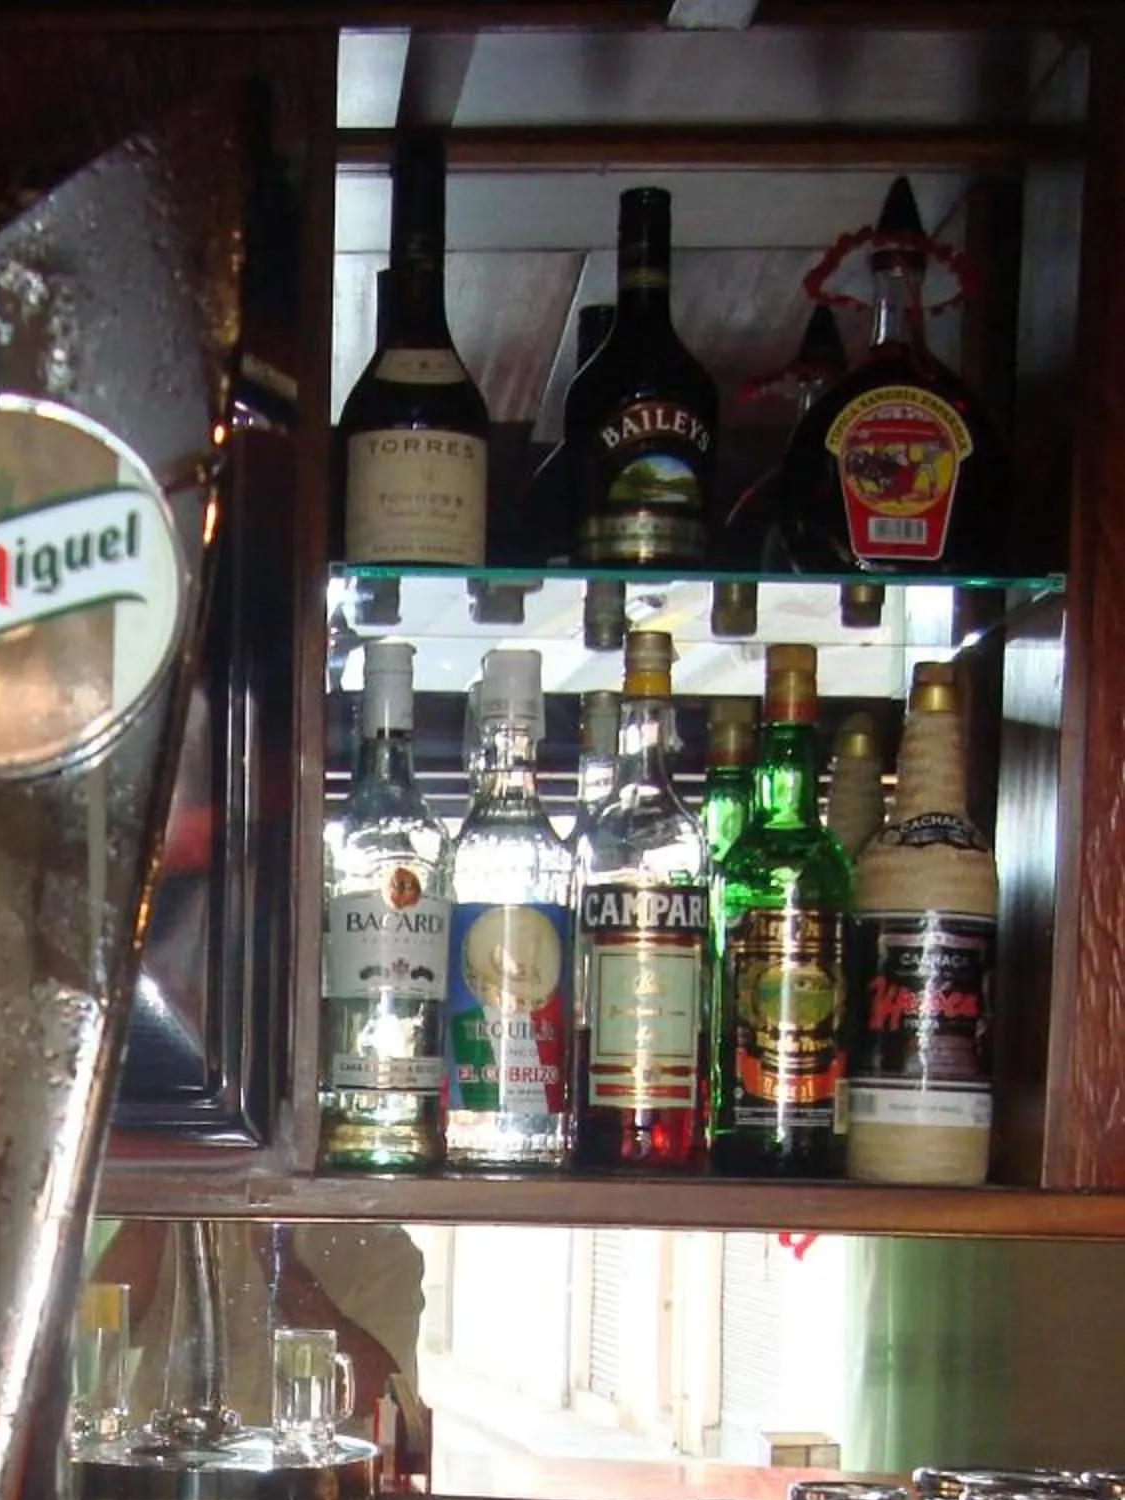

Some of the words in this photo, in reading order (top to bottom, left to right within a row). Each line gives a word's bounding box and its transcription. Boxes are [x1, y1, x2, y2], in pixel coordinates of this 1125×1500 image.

[601, 408, 711, 452] BAILEYS
[368, 438, 475, 461] TORRES
[346, 911, 444, 934] BACARD
[586, 890, 708, 928] CAMPARI
